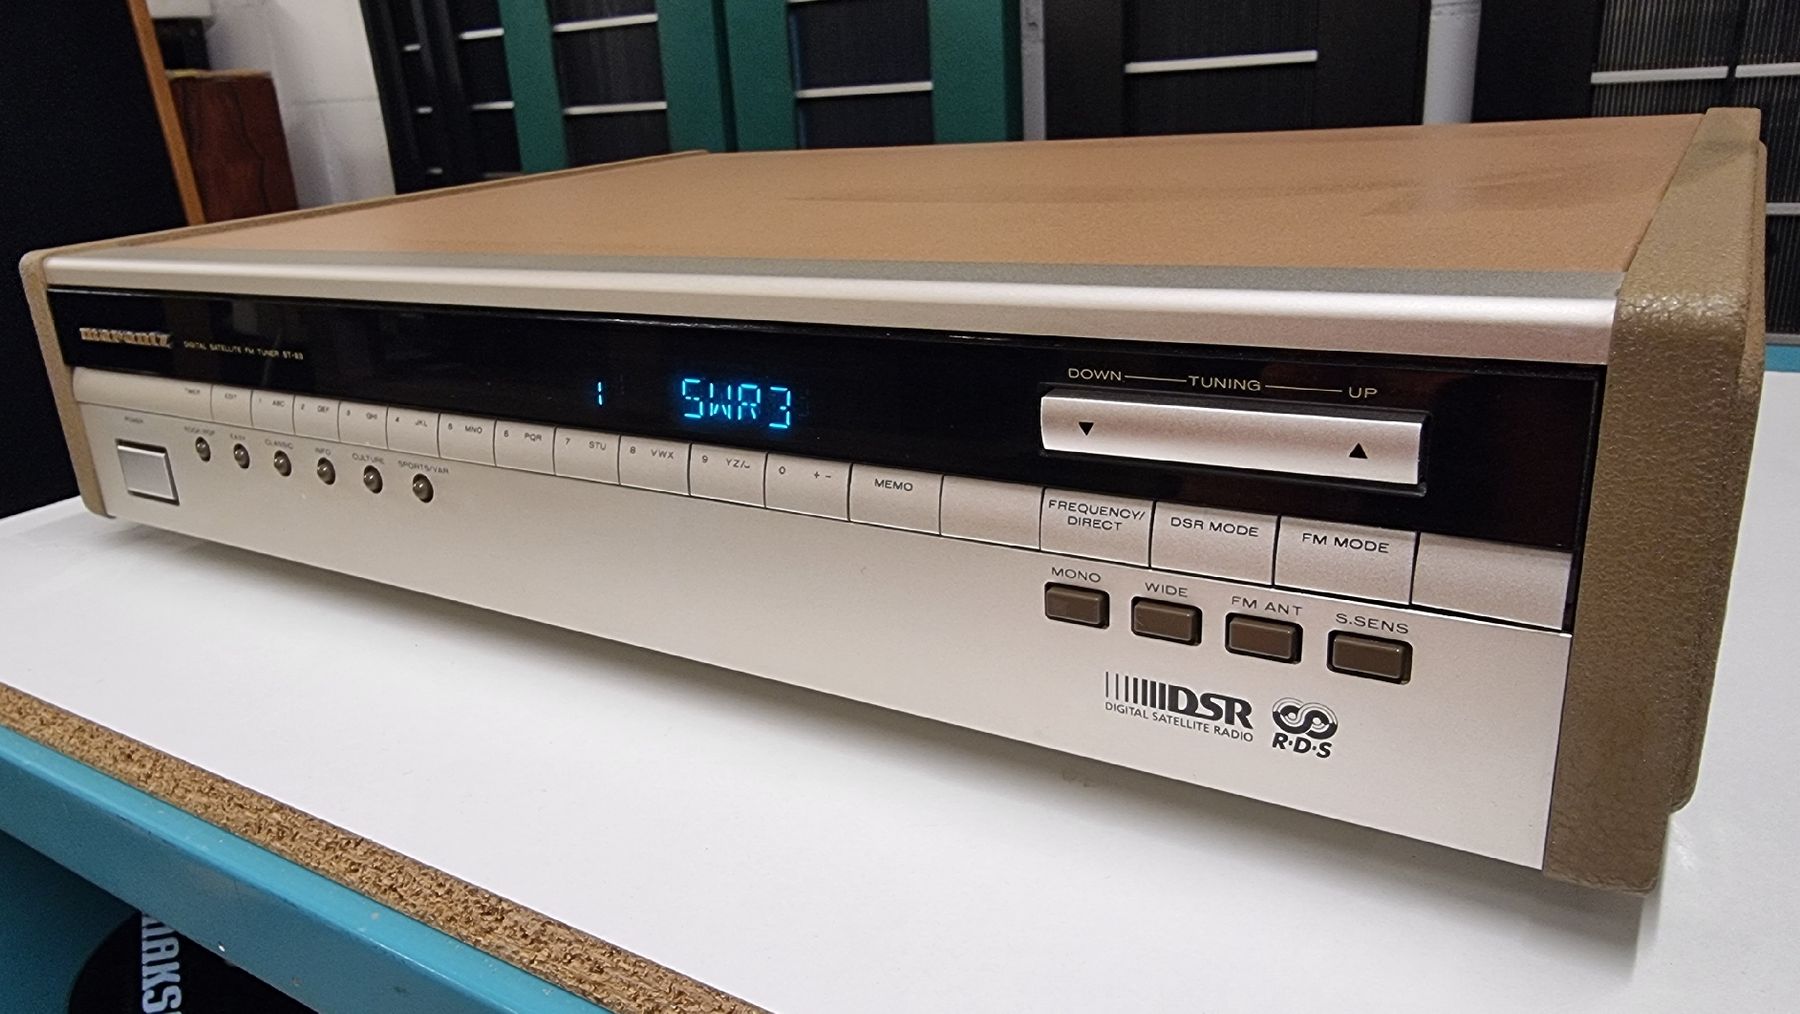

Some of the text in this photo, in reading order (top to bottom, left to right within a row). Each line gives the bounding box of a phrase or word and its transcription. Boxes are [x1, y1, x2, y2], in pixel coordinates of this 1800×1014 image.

[209, 343, 242, 353] SATELLITE
[1067, 367, 1379, 399] DOWN TUNING UP
[272, 400, 286, 408] ABC
[317, 405, 331, 414] DEF
[346, 409, 351, 417] 3
[366, 411, 379, 420] GHI
[395, 415, 400, 423] 4
[415, 419, 428, 428] JKL
[447, 423, 453, 431] 5
[464, 425, 483, 435] MNO
[503, 430, 509, 438] 6
[524, 432, 543, 442] PQR
[565, 437, 571, 446] 7
[264, 438, 294, 451] CLASSIC
[588, 440, 607, 450] STU
[315, 447, 332, 456] INFO
[629, 446, 636, 455] 8
[650, 448, 675, 460] VWX
[352, 452, 385, 465] CULTURE
[702, 455, 709, 463] 9
[398, 460, 449, 474] SPORTS/VAR
[778, 465, 786, 475] 0
[873, 478, 914, 492] MEMO
[1048, 499, 1146, 521] FREQUENCY/
[1067, 515, 1123, 531] DIRECT
[1170, 516, 1260, 538] DSR MODE
[1301, 532, 1390, 554] FM MODE
[1051, 566, 1102, 584] MONO
[1144, 581, 1189, 598] WIDE
[1230, 595, 1303, 617] FM ANT
[1335, 612, 1410, 635] S.SENS
[1167, 684, 1255, 730] DSR
[1104, 701, 1254, 743] DIGITAL SATELLITE RADIO
